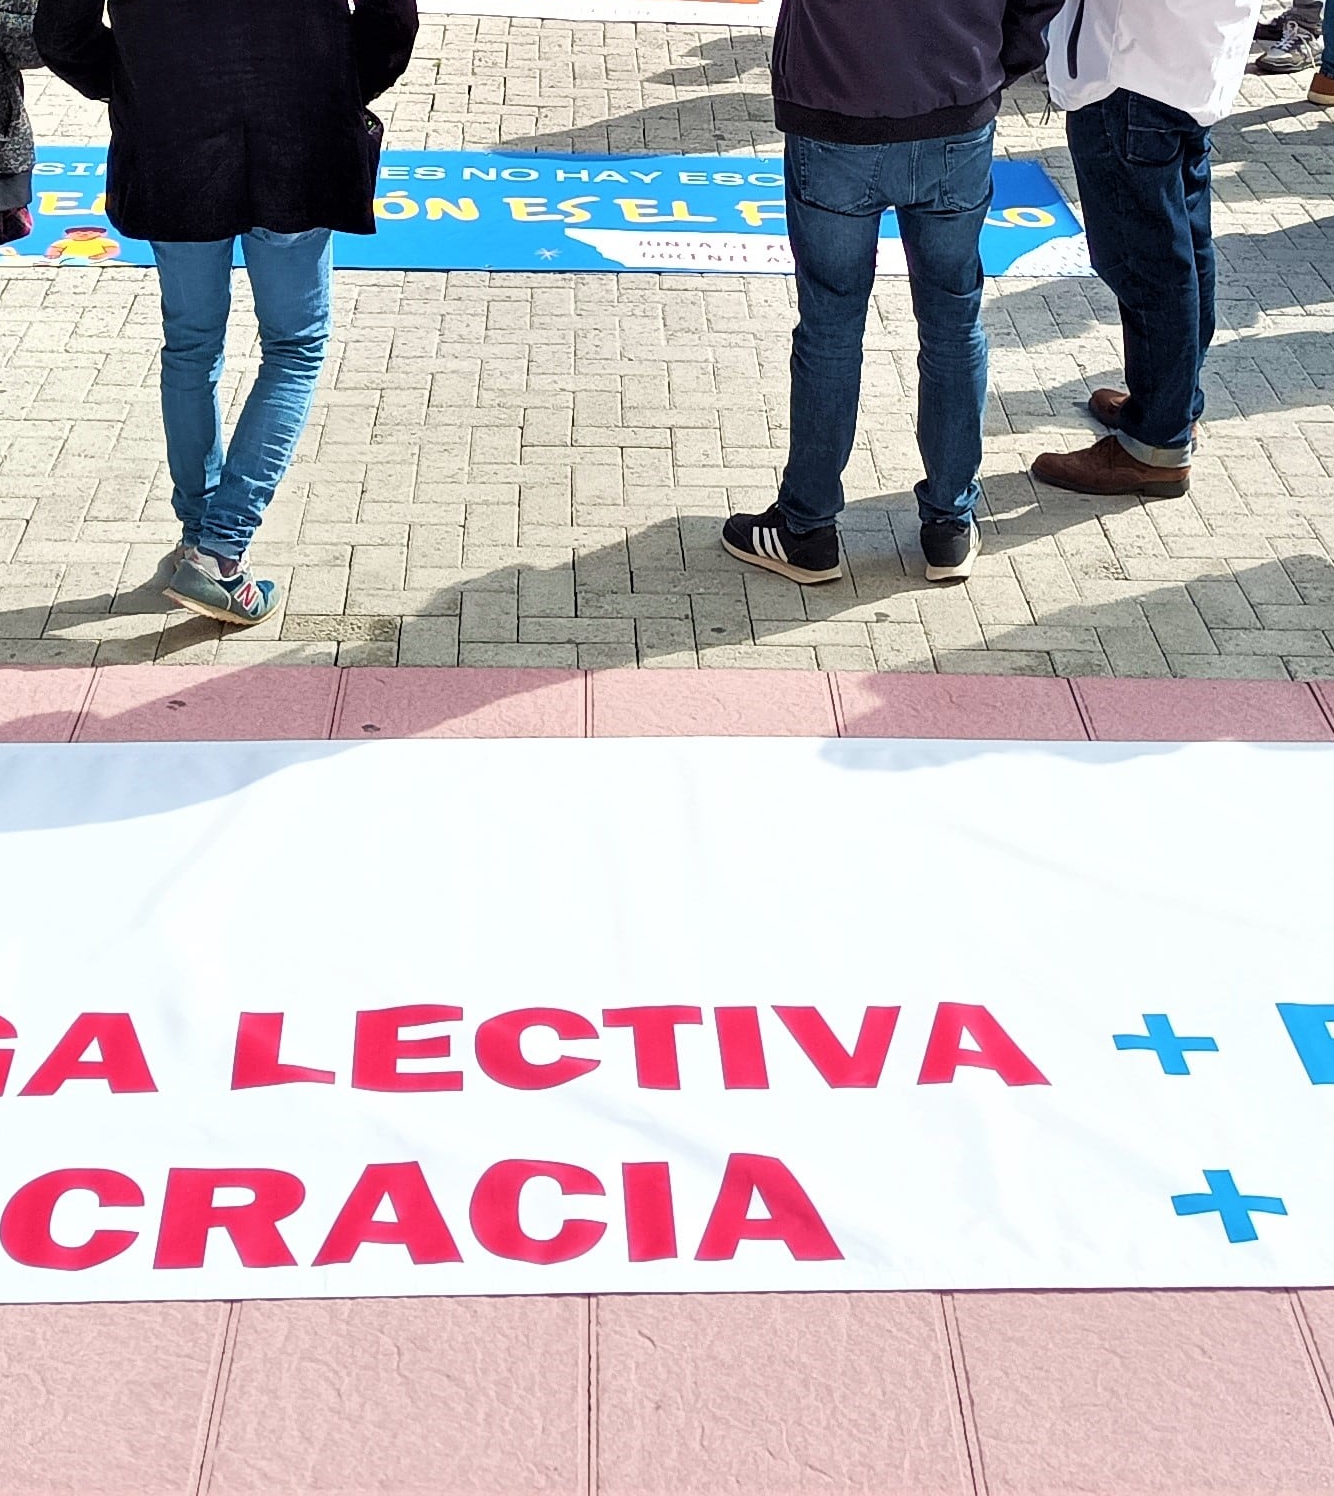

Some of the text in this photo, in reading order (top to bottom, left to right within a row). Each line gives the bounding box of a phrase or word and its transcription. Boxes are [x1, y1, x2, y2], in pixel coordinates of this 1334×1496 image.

[462, 167, 539, 182] NO
[556, 169, 663, 185] HAY
[502, 196, 601, 224] ES
[613, 198, 717, 223] EL
[230, 1002, 1052, 1092] LECTIVA
